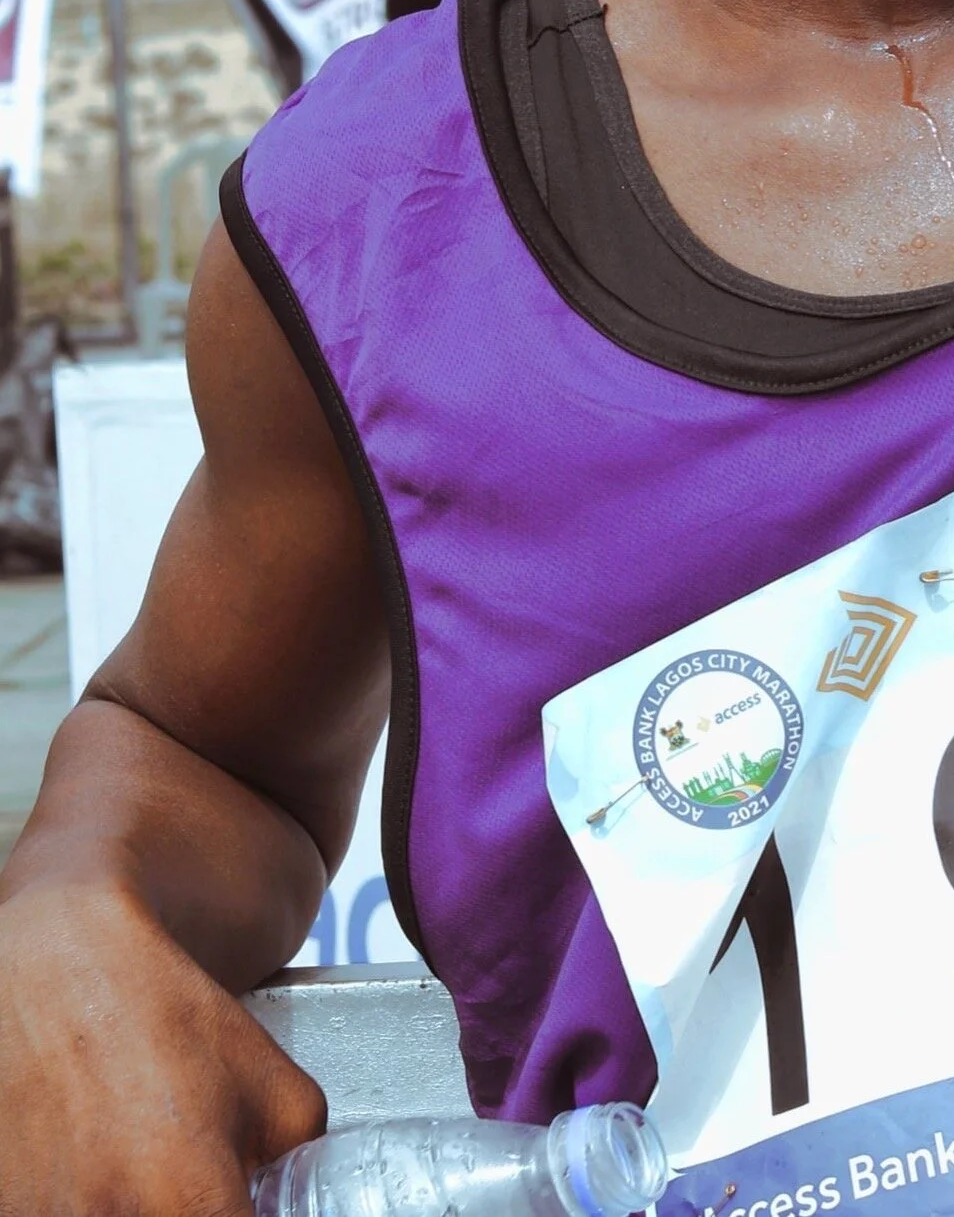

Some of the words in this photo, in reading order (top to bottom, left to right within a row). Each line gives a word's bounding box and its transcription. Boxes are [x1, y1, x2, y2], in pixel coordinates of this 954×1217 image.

[648, 656, 703, 706] LAGOS
[707, 654, 751, 672] CITY
[714, 693, 762, 725] access
[752, 666, 802, 770] MARATHON
[639, 708, 656, 763] BANK
[646, 767, 704, 822] ACCESS
[727, 796, 770, 827] 2021
